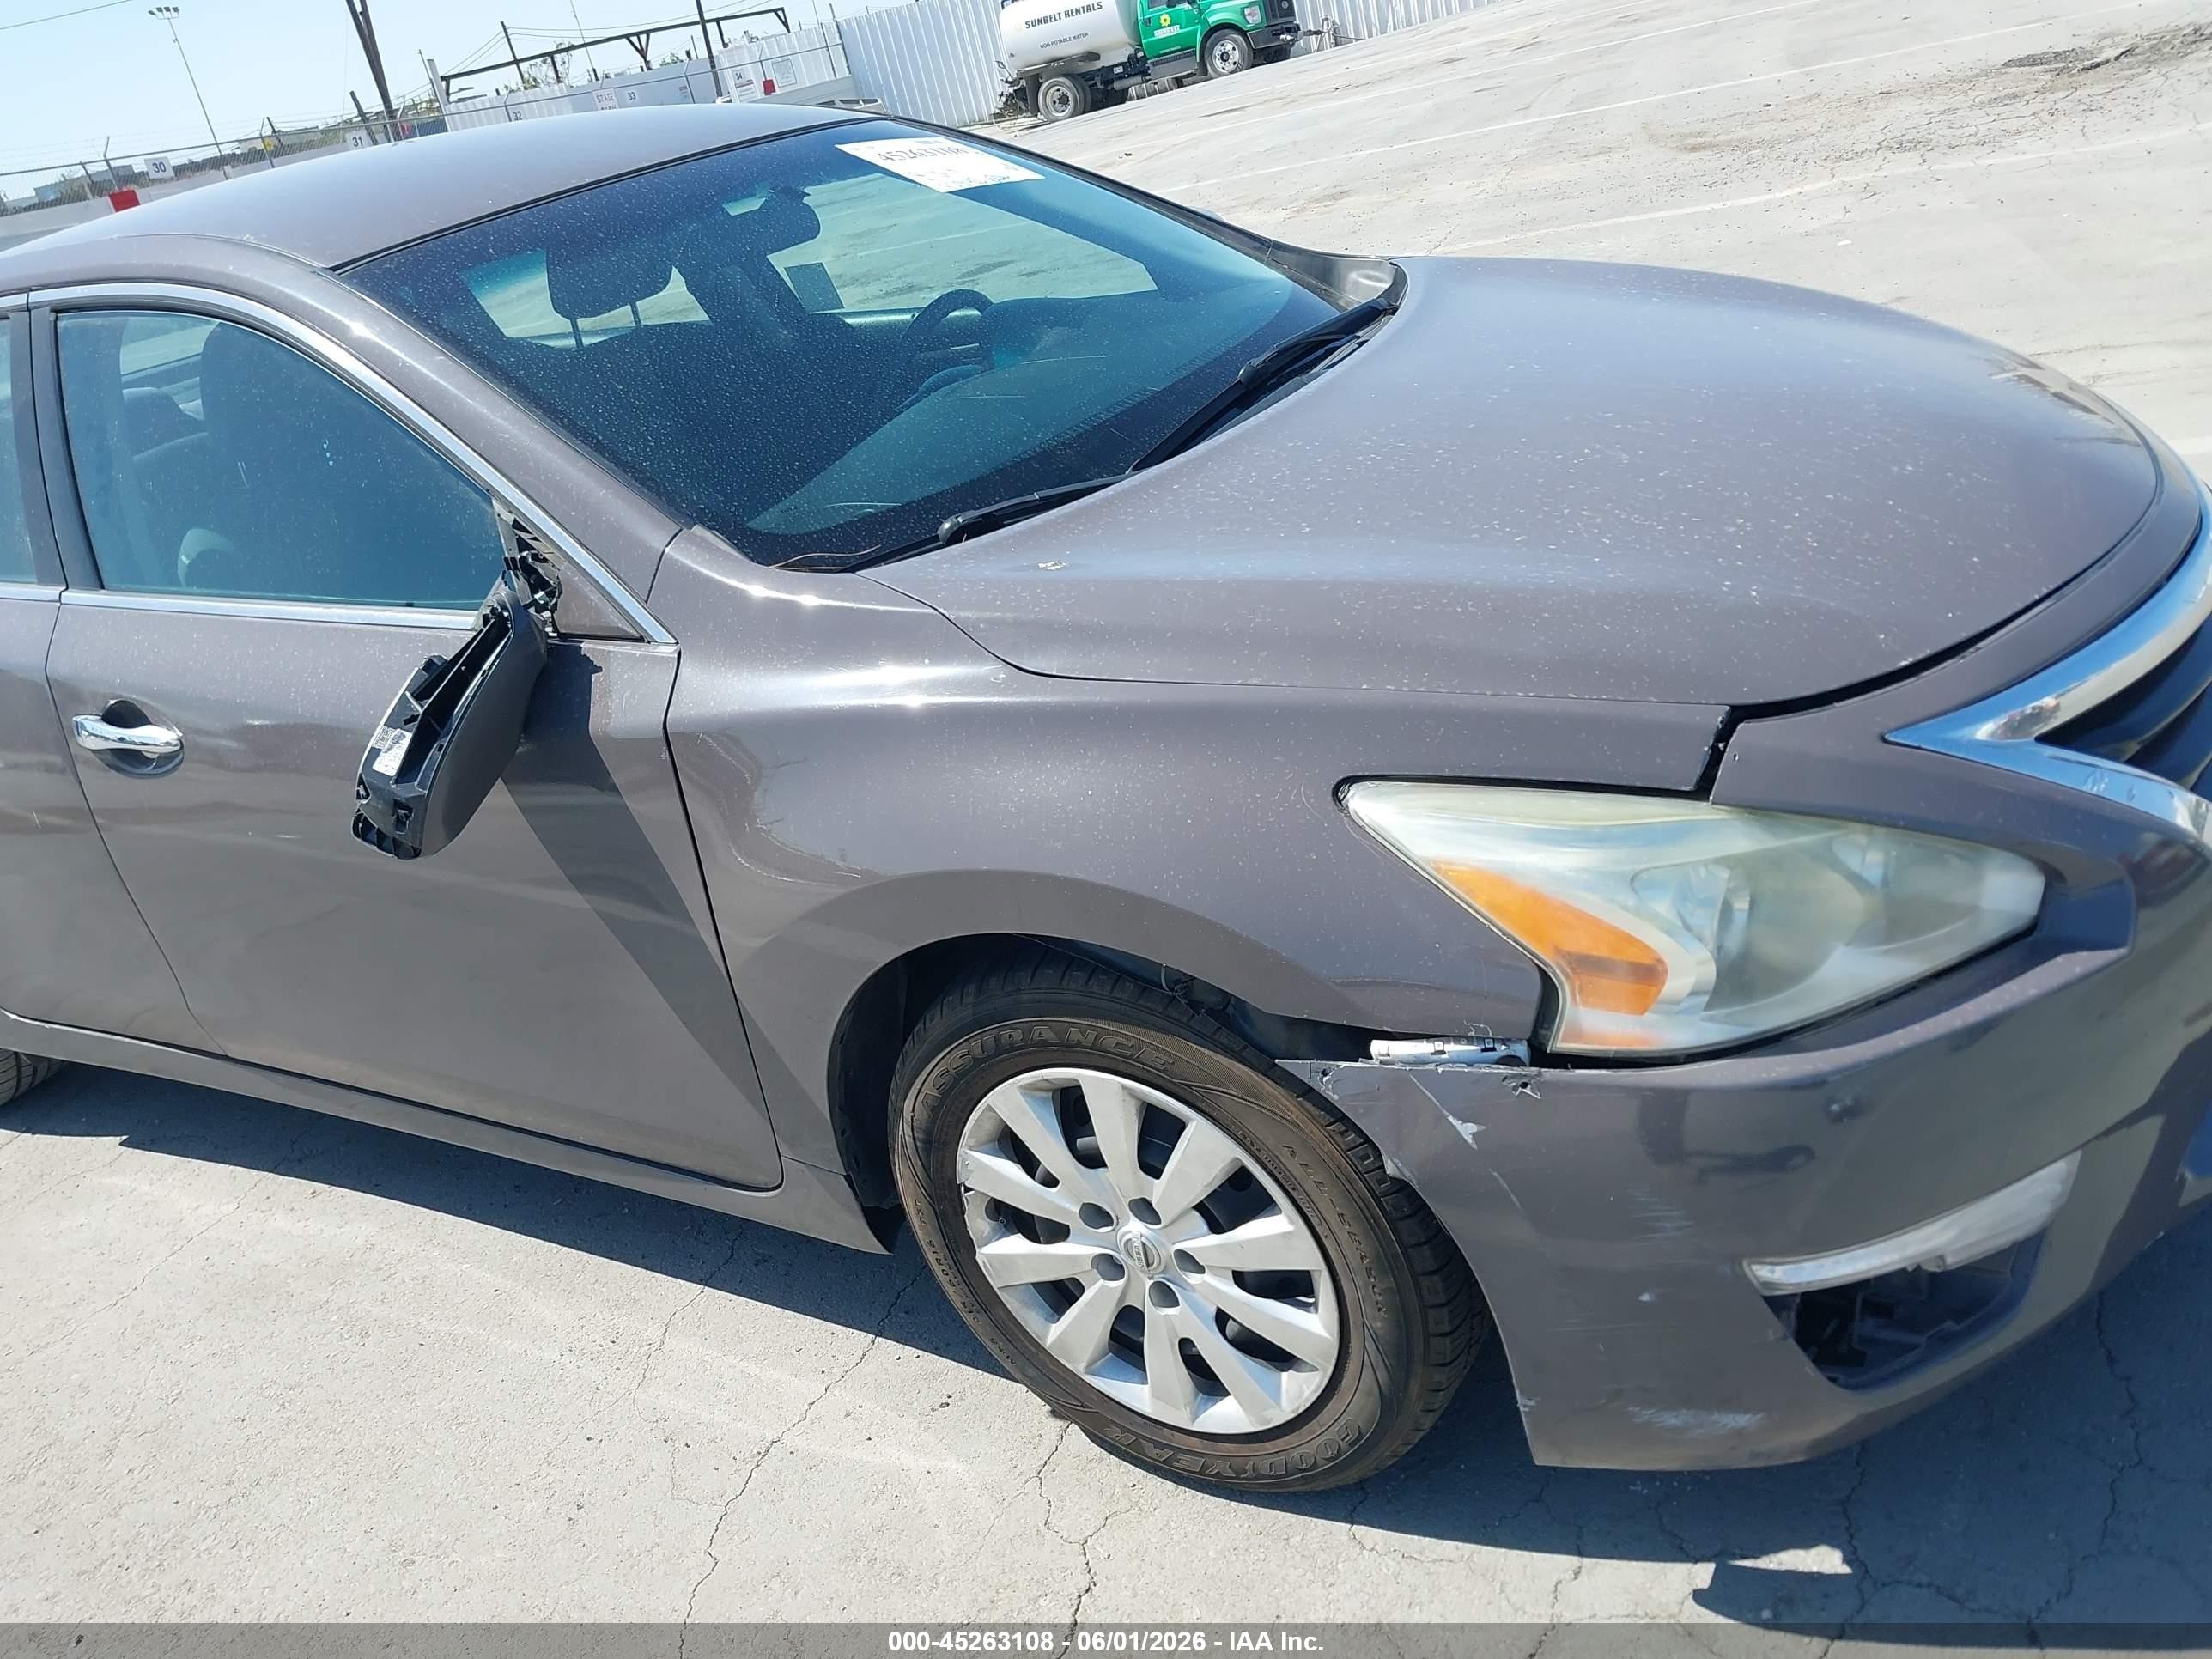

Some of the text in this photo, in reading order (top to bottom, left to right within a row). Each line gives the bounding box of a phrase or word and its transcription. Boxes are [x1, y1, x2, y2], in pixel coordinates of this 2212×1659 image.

[1025, 1, 1103, 29] SUNBELT RENTALS
[1040, 32, 1090, 49] NON-POTABLE WATER
[735, 72, 743, 82] 34
[596, 92, 614, 104] STATE
[627, 91, 636, 101] 33
[513, 110, 523, 121] 32
[353, 135, 363, 149] 31
[152, 161, 167, 174] 30
[921, 1026, 1175, 1114] ASSURANCE
[1280, 1144, 1389, 1320] ALL-SEASON
[1103, 1418, 1362, 1480] GOODYEAR
